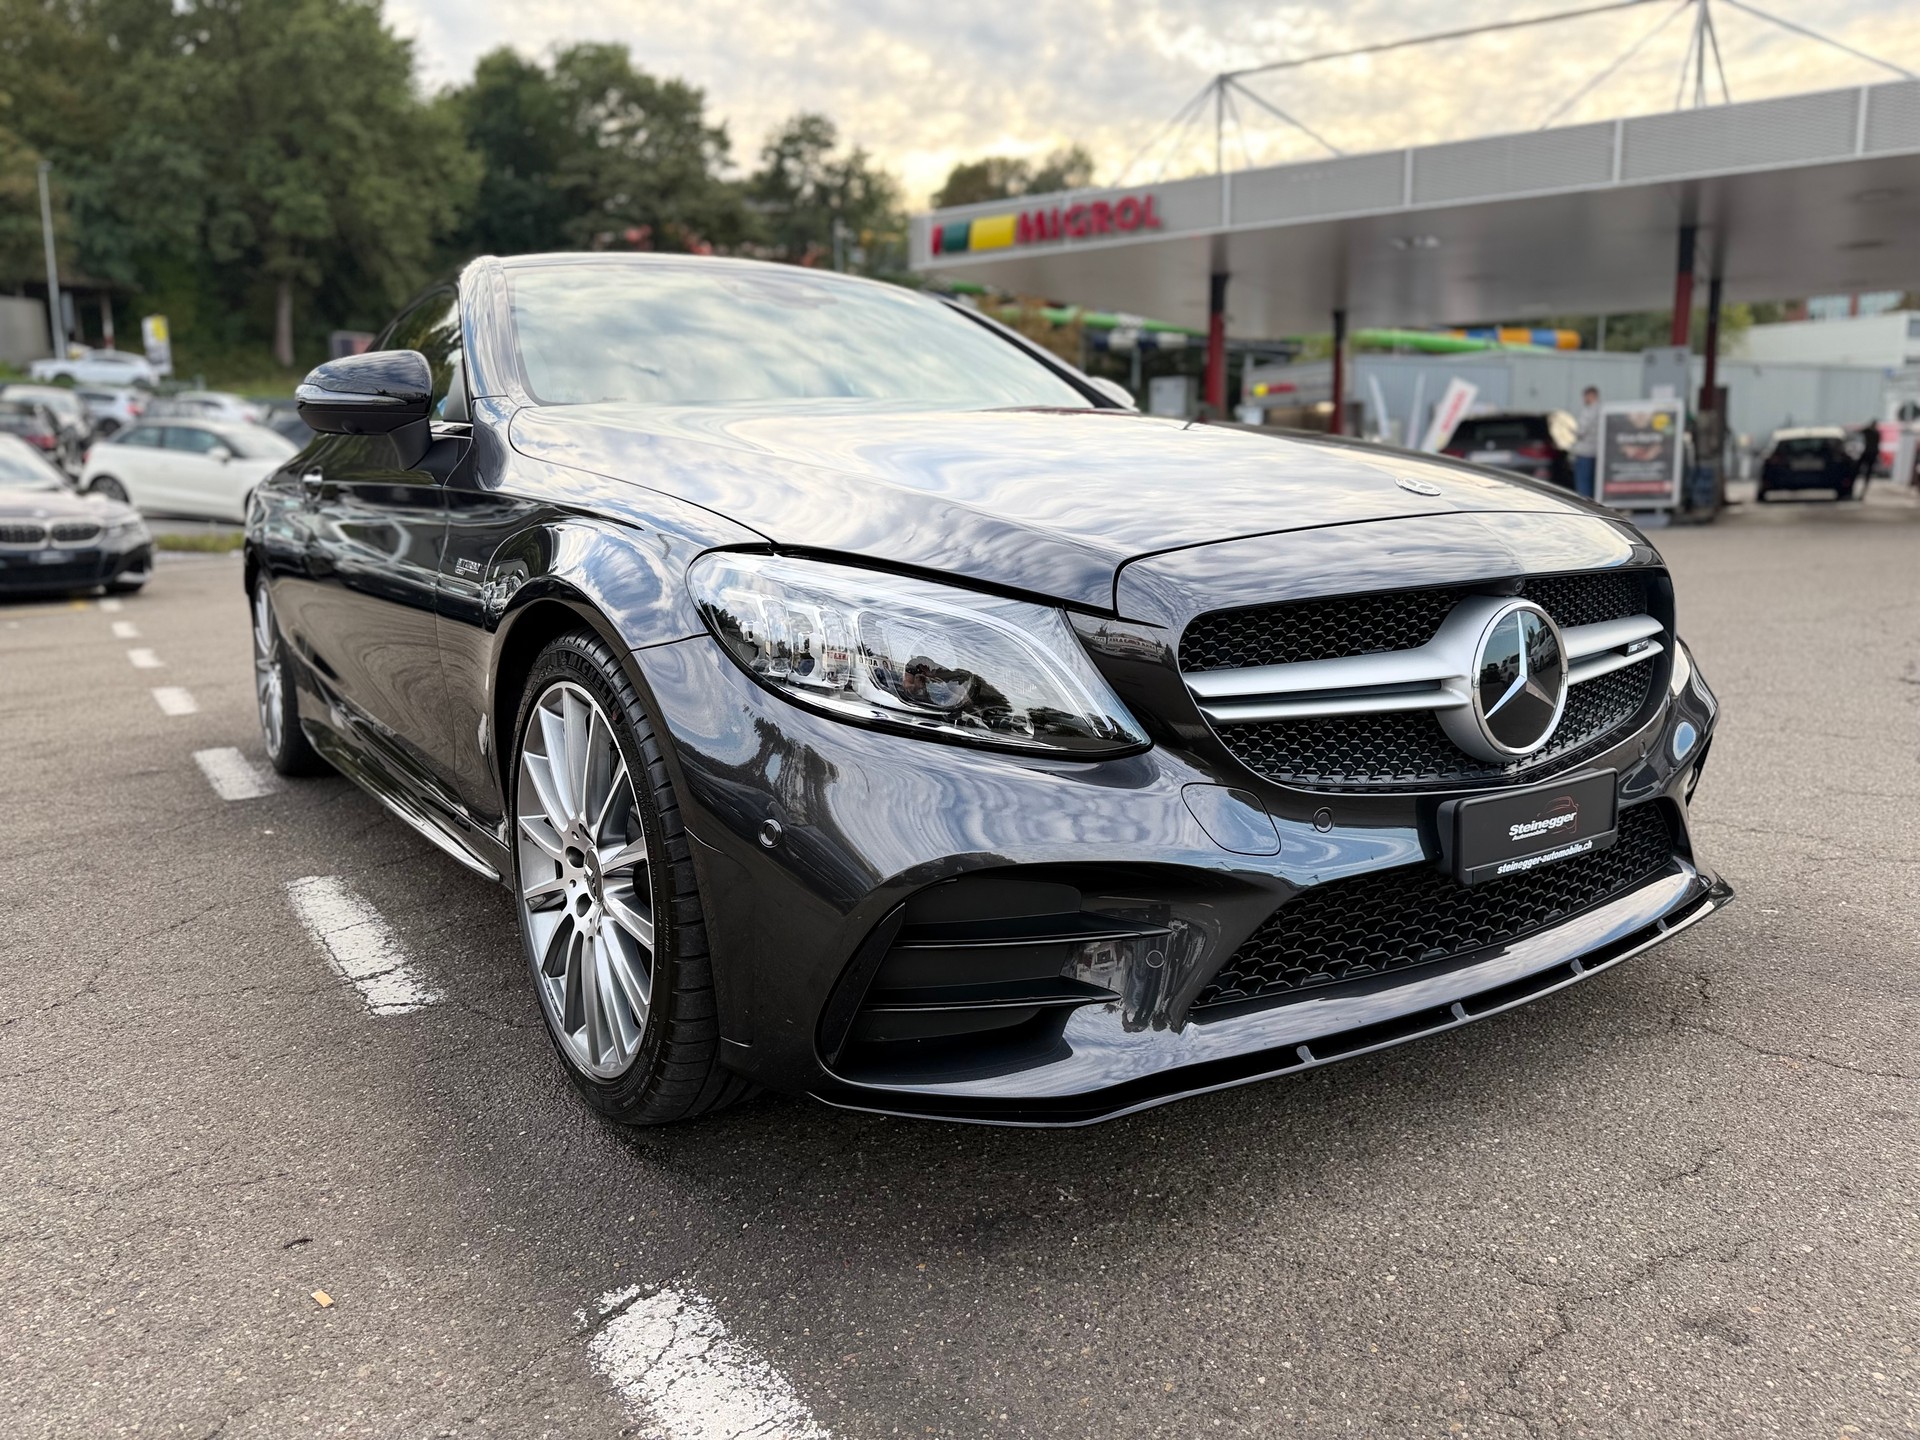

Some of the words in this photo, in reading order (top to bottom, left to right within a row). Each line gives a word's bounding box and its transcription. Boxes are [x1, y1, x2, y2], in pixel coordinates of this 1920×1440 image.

[1017, 194, 1160, 246] MIGROL
[568, 653, 620, 713] MICHELIN
[1509, 812, 1577, 836] Steinegger
[1497, 840, 1593, 874] steinegger-automobile.ch
